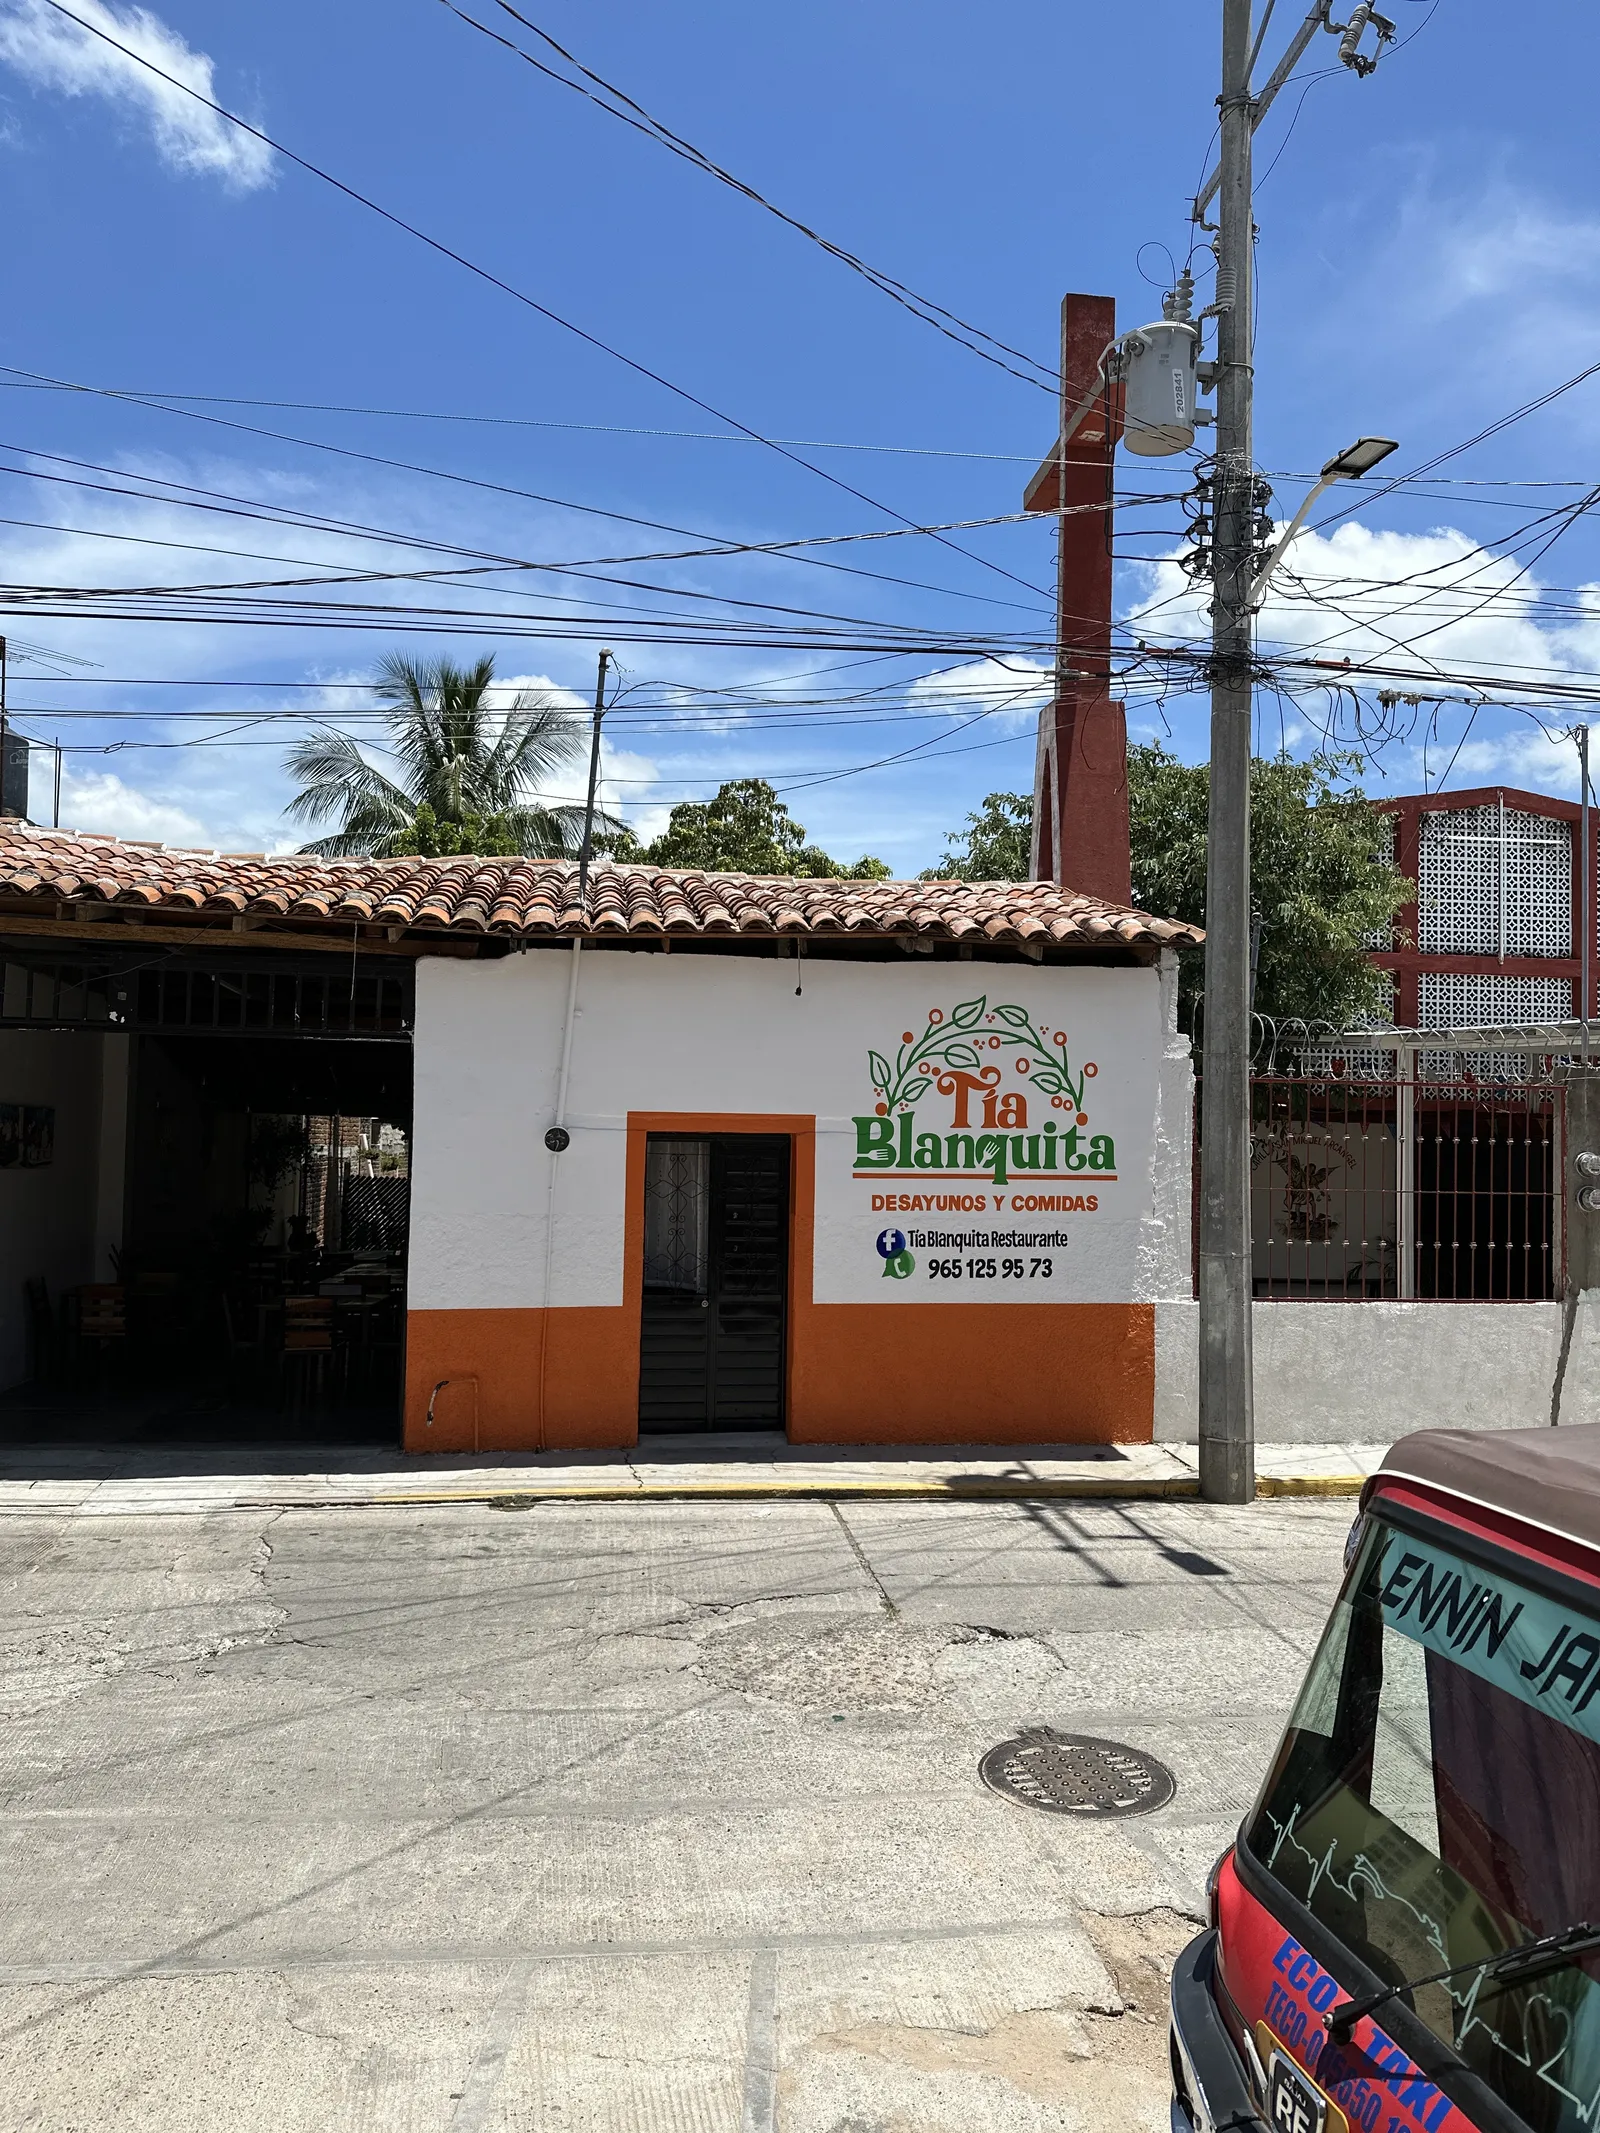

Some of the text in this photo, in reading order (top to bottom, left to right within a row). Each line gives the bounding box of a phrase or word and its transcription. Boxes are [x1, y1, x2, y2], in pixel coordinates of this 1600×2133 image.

[1174, 373, 1184, 413] 202841
[937, 1066, 1028, 1129] Tía
[852, 1111, 1117, 1185] Blanquita
[872, 1194, 1099, 1212] DESAYUNOS Y COMIDAS
[928, 1229, 989, 1253] Blanquita
[991, 1230, 1068, 1248] Restaurante
[928, 1258, 1053, 1279] 965 125 95 73
[1361, 1537, 1600, 1715] LENNIN JA
[1272, 1936, 1453, 2133] ECO TAXI
[1454, 2038, 1463, 2051] 5
[1491, 2031, 1501, 2044] 6
